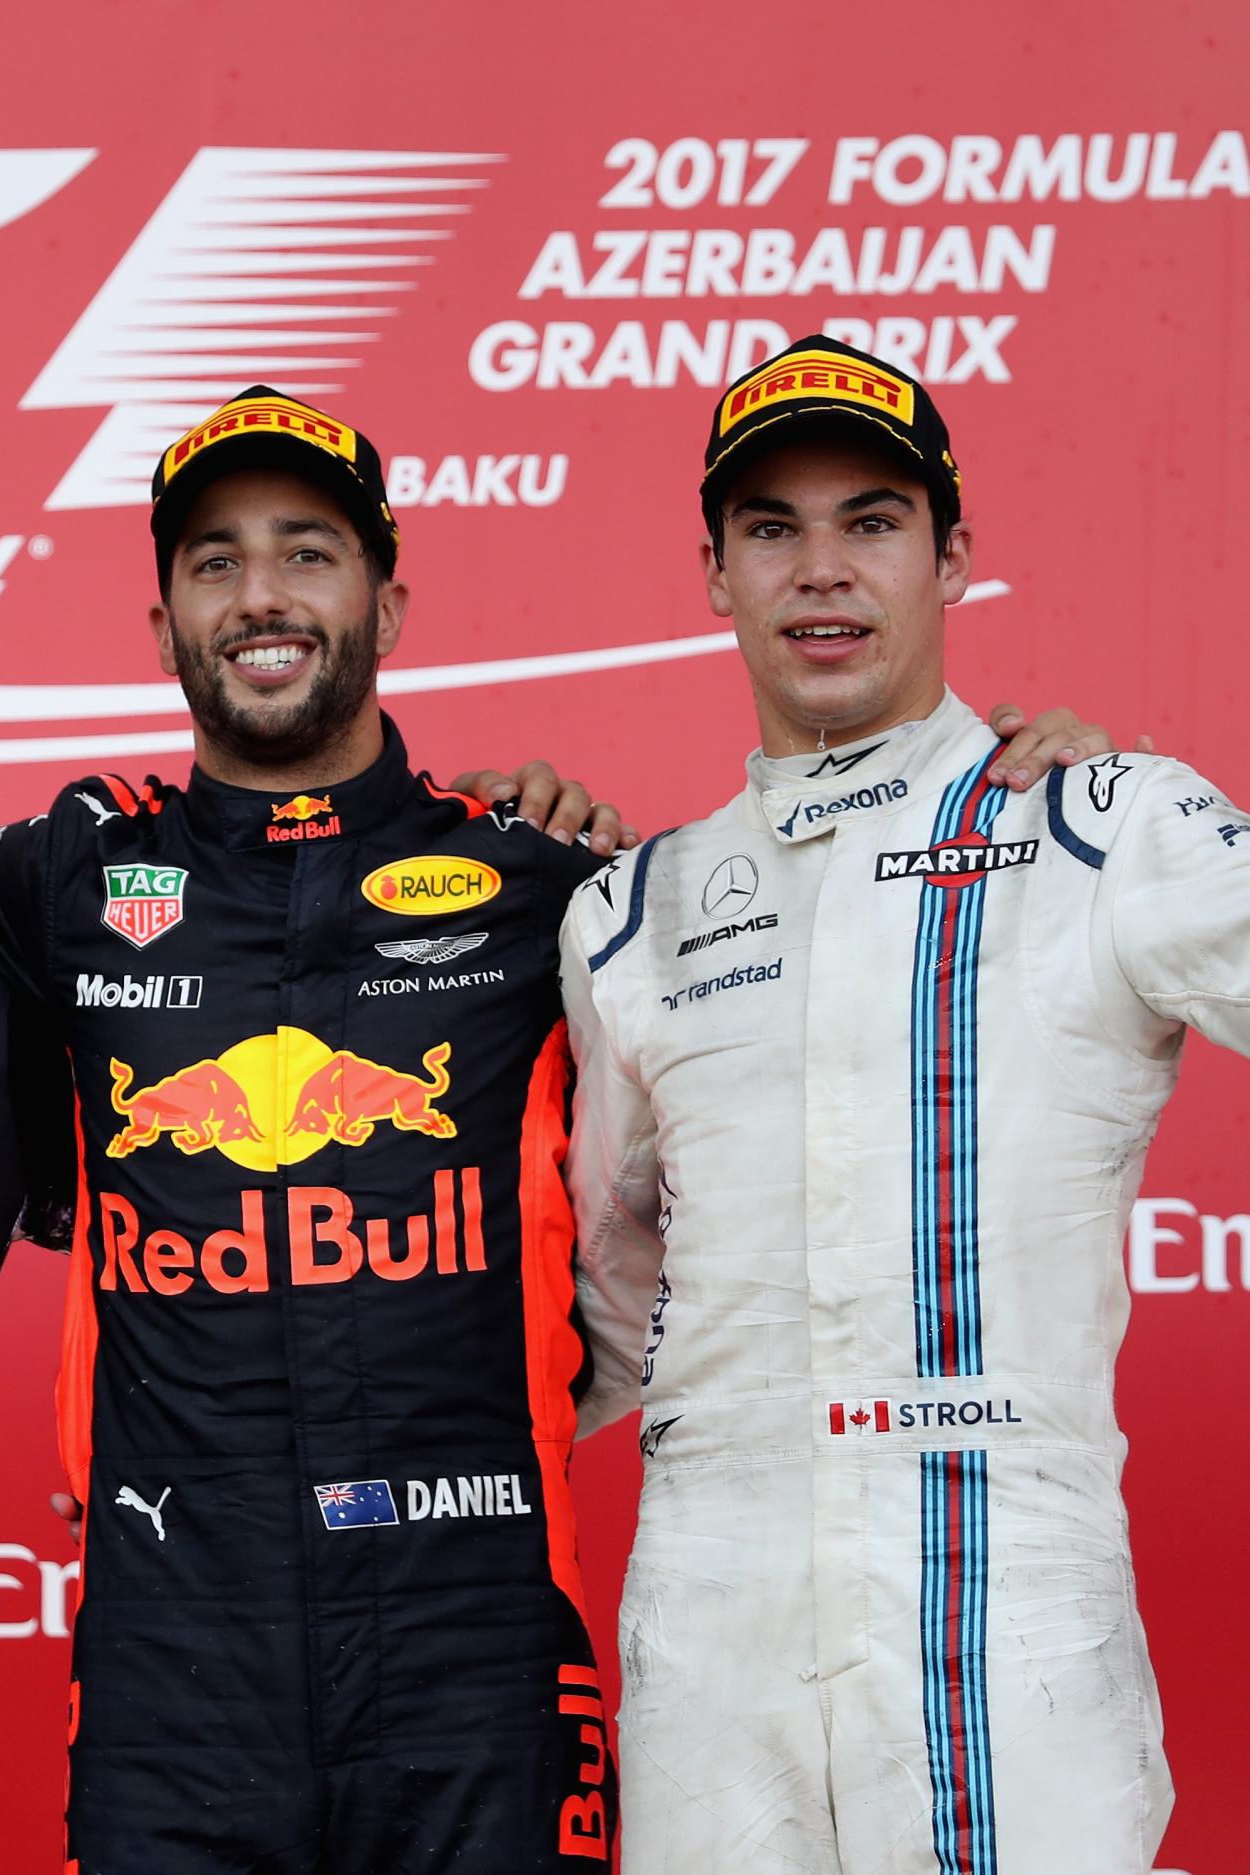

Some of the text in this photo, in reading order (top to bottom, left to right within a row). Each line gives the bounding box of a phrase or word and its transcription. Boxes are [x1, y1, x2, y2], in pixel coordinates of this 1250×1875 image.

[600, 130, 1250, 209] 2017 FORMULA
[517, 225, 1056, 299] AZERBAIJAN
[468, 315, 1018, 391] GRAND PRIX
[730, 359, 901, 418] PIRELLI
[174, 404, 342, 465] PIRELLI
[389, 454, 570, 508] BAKU
[805, 778, 908, 823] Rexona
[267, 815, 341, 842] Red Bull
[111, 870, 178, 894] TAG
[880, 842, 1035, 878] MARTINI
[401, 873, 482, 898] RAUCH
[109, 901, 178, 940] HEUER
[707, 913, 779, 943] AMG
[76, 973, 165, 1008] Mobil
[358, 969, 504, 996] ASTON MARTIN
[688, 957, 784, 1002] randstad
[99, 1167, 488, 1294] Red Bull
[899, 1399, 1022, 1428] STROLL
[406, 1474, 532, 1520] DANIEL
[558, 1663, 608, 1862] Bull
